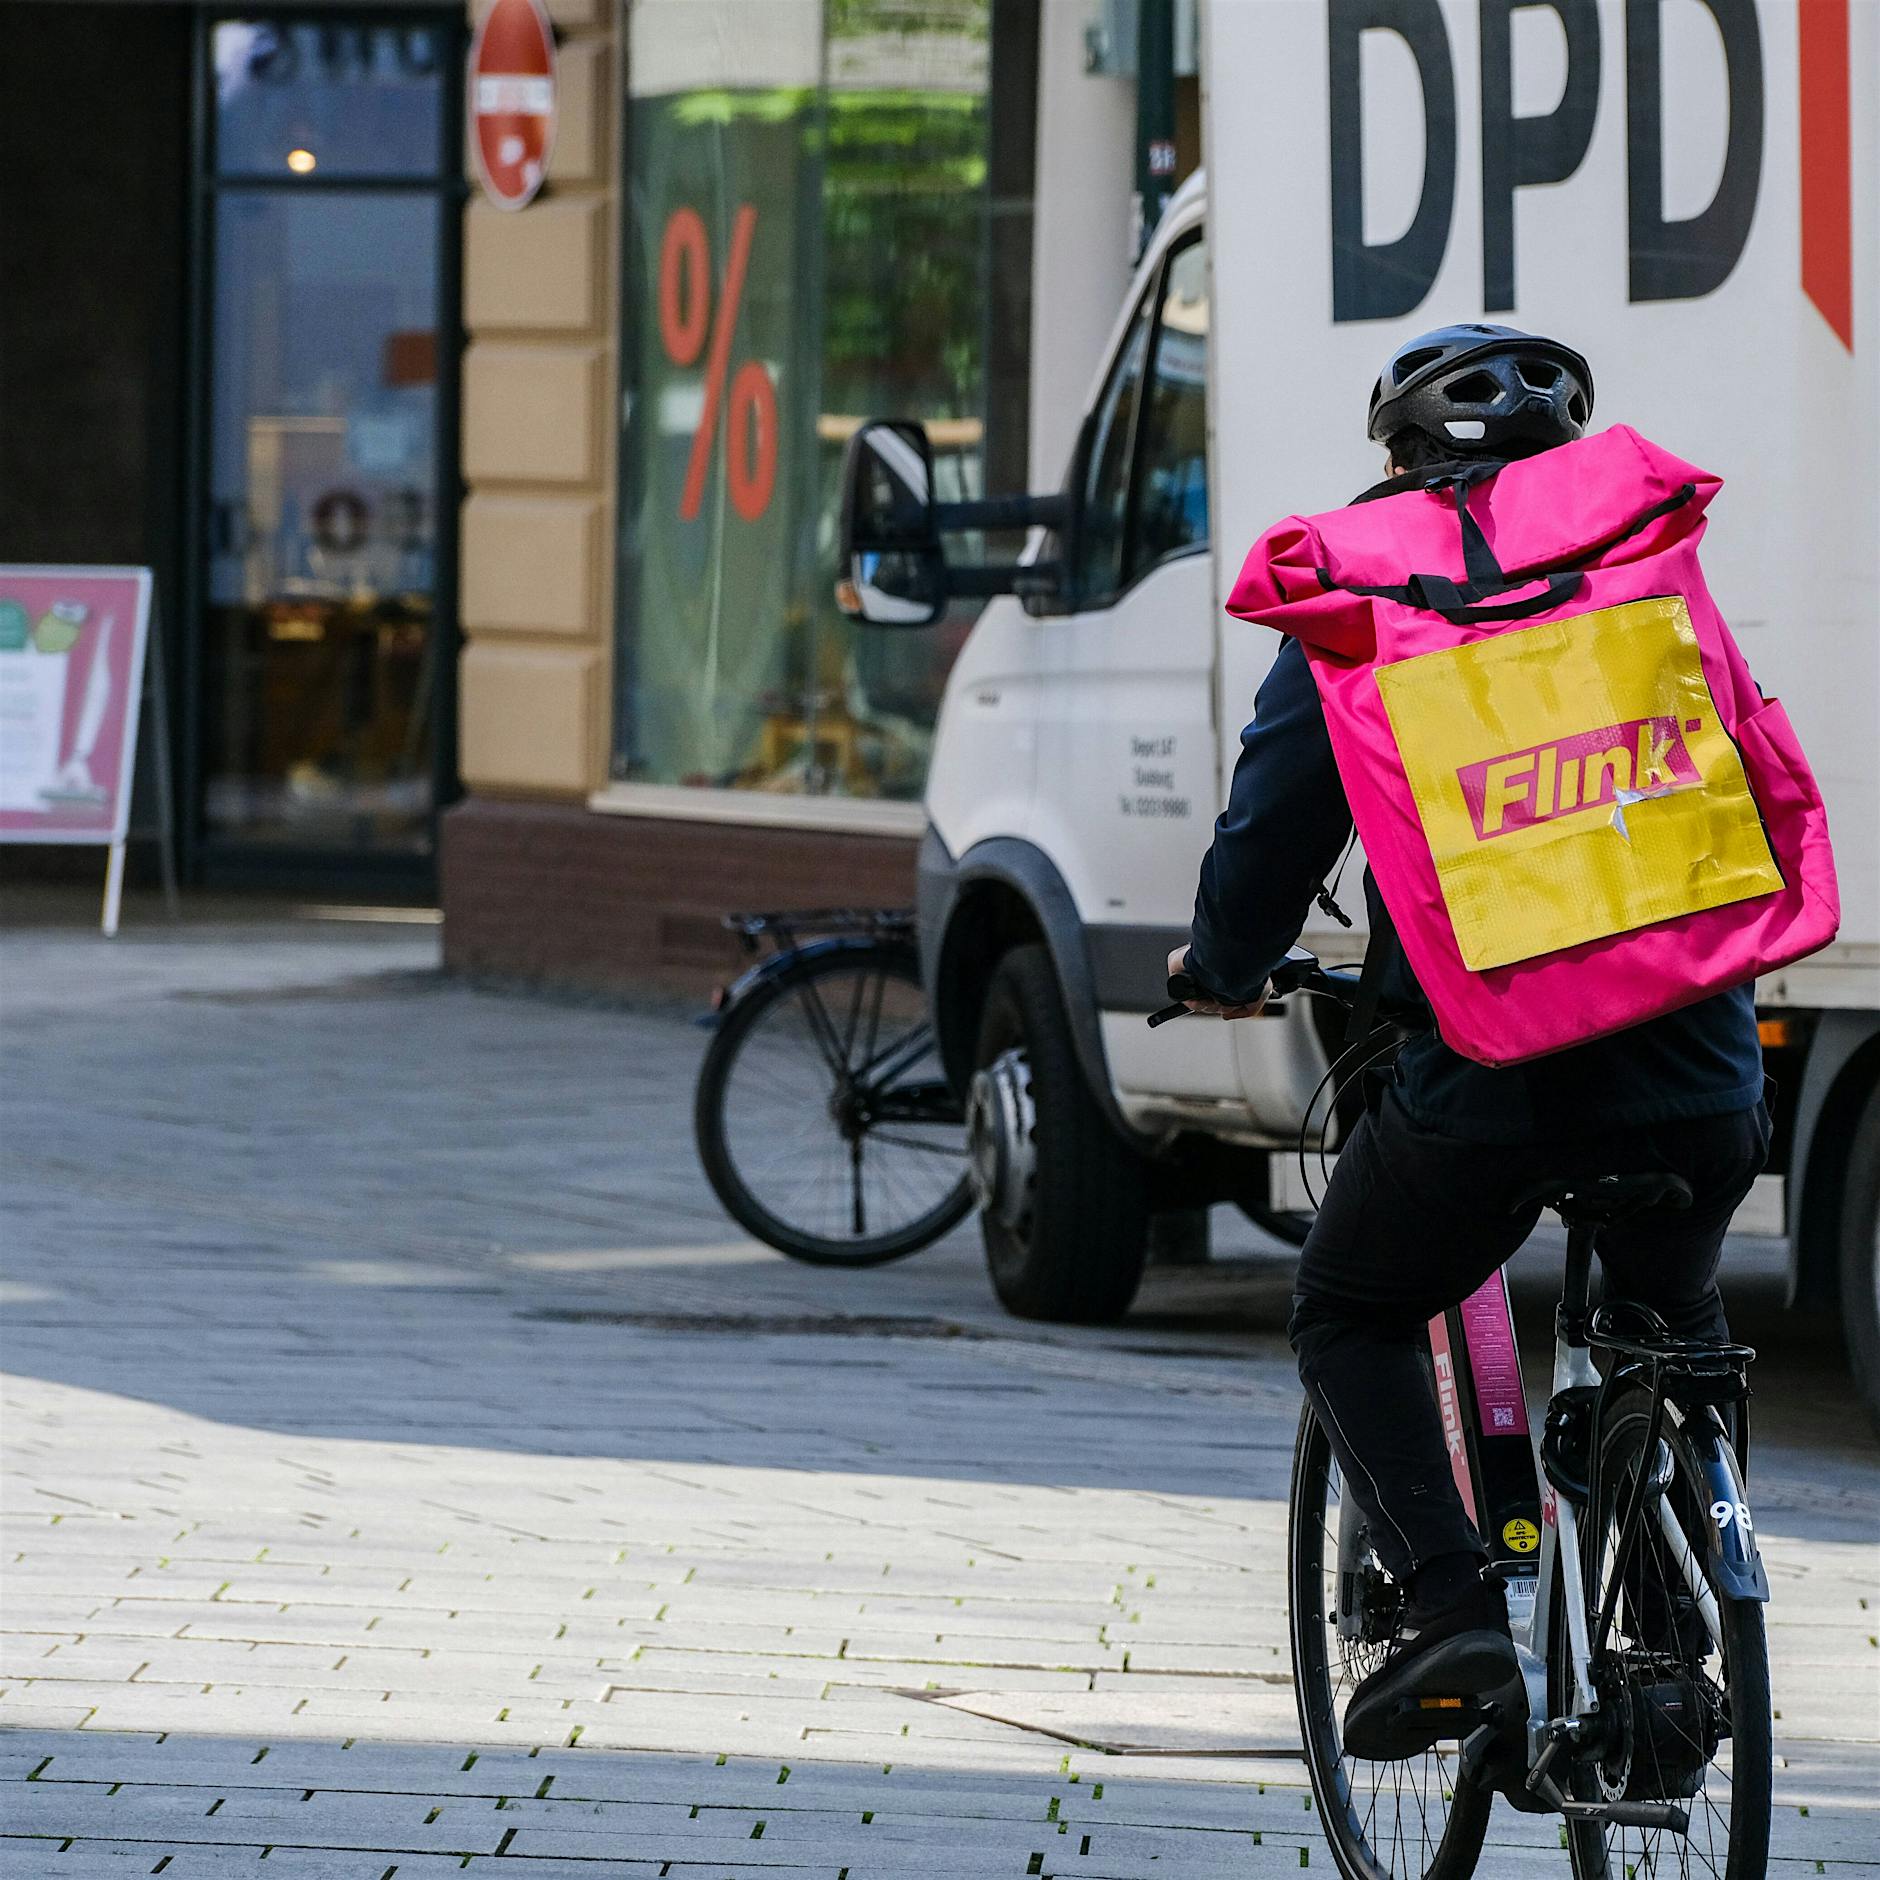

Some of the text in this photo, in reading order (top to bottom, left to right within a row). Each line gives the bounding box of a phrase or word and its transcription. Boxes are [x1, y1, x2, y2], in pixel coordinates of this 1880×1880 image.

[1328, 0, 1764, 323] DPD
[658, 202, 778, 522] %
[1483, 723, 1679, 834] Flink
[1435, 1352, 1461, 1458] Flink
[1710, 1500, 1753, 1531] 98
